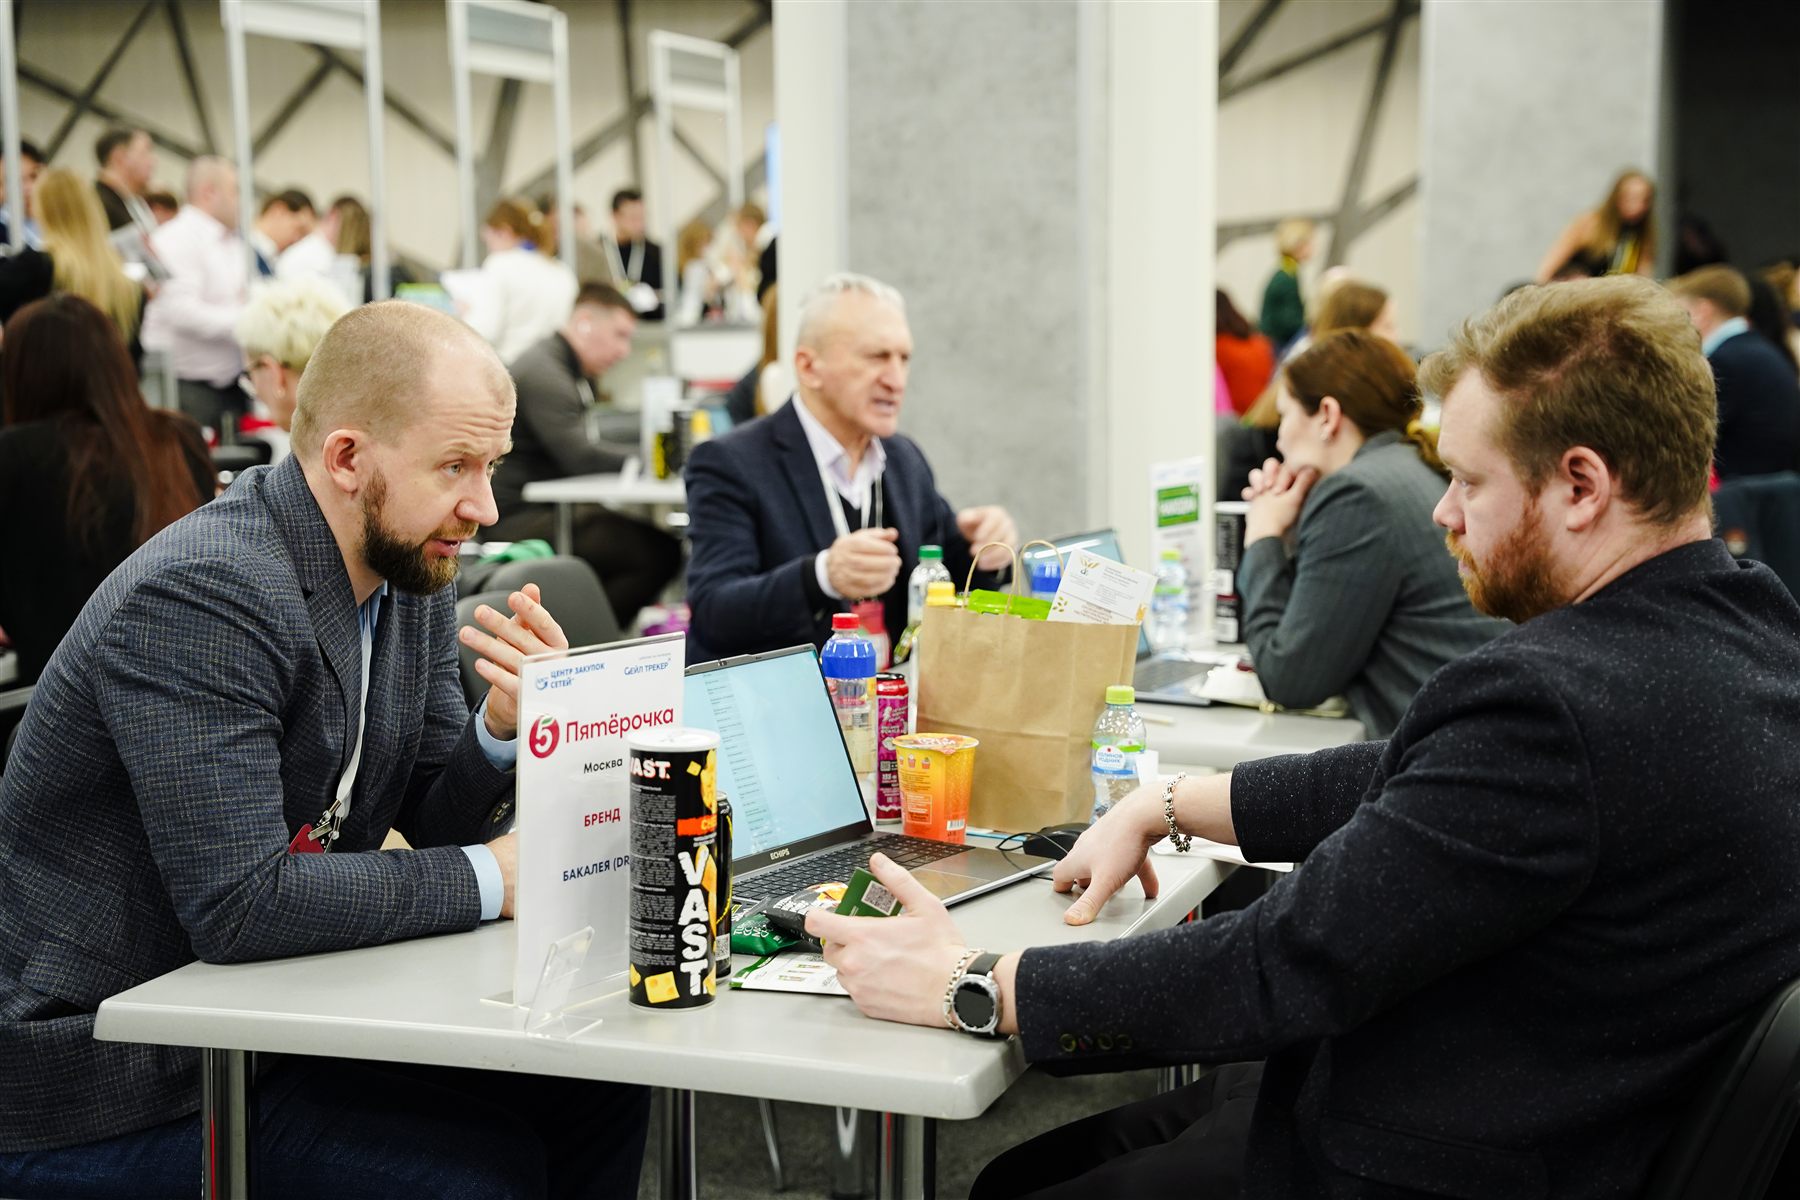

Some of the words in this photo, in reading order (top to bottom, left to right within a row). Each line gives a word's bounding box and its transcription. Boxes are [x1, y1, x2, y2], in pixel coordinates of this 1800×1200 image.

[551, 668, 573, 678] ЦЕНТР
[575, 663, 605, 674] ЗАКУПОК
[645, 662, 668, 672] ТРЕКЕР
[566, 708, 674, 743] Пятёрочка
[584, 758, 623, 774] Москва
[584, 808, 620, 827] БРЕНД
[563, 860, 610, 881] БАКАЛЕЯ
